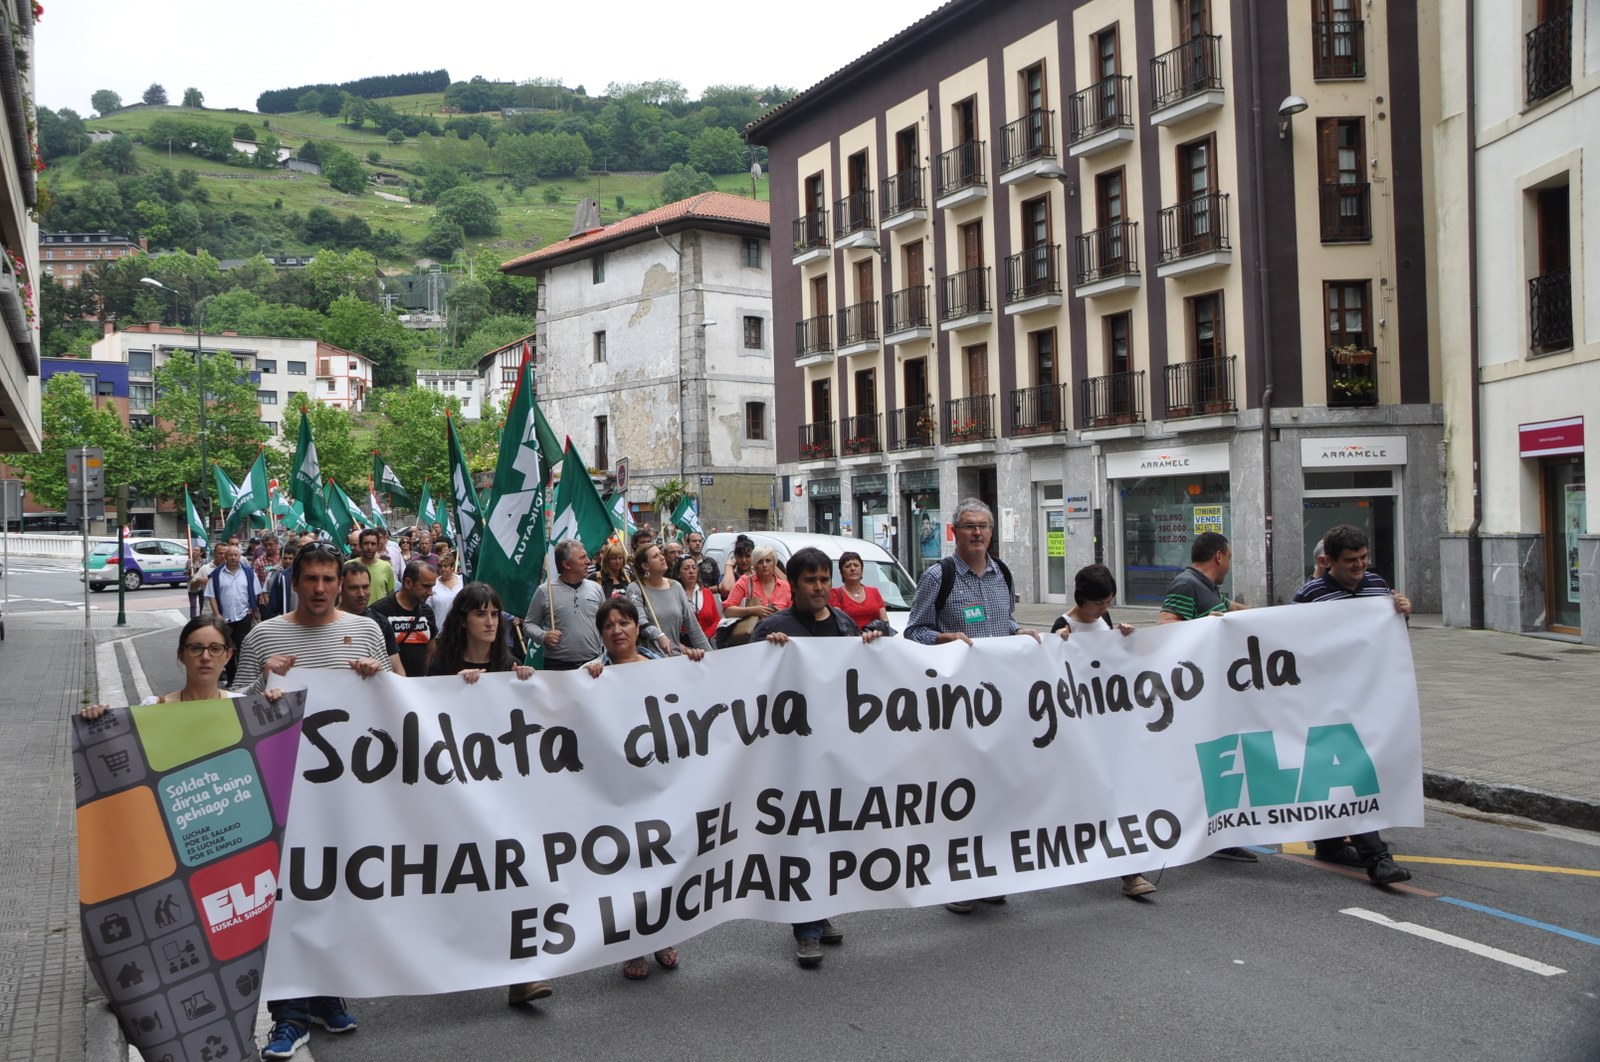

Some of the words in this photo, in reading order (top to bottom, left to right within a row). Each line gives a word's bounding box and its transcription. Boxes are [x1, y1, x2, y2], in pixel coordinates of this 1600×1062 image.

[1140, 459, 1190, 469] ARRAMELE
[1322, 450, 1387, 459] ARRAMELE
[1195, 515, 1222, 523] VENDE
[1201, 507, 1221, 515] MINER
[301, 707, 585, 786] Soldata
[623, 689, 813, 769] dirua
[845, 667, 1003, 734] baino
[1028, 660, 1205, 749] gehiago
[1226, 635, 1302, 692] da
[1194, 722, 1381, 819] ELA
[166, 771, 221, 799] Soldata
[171, 789, 211, 812] dirua
[213, 773, 253, 796] baino
[175, 797, 230, 831] gehiago
[233, 789, 253, 804] da
[1207, 810, 1262, 837] EUSKAL
[1267, 797, 1381, 825] SINDIKATUA
[182, 825, 211, 841] LUCHAR
[184, 836, 201, 848] POR
[201, 832, 210, 843] EL
[210, 822, 241, 839] SALARIO
[187, 846, 197, 856] ES
[197, 836, 225, 852] LUCHAR
[276, 838, 529, 902] UCHAR
[542, 819, 677, 883] POR
[695, 800, 739, 857] EL
[754, 777, 977, 837] SALARIO
[189, 851, 206, 862] POR
[207, 847, 216, 857] EL
[215, 836, 243, 854] EMPLEO
[201, 868, 278, 927] ELA
[509, 902, 576, 960] ES
[598, 852, 812, 946] LUCHAR
[829, 843, 932, 897] POR
[947, 835, 998, 882] EL
[1010, 808, 1182, 873] EMPLEO
[210, 916, 244, 934] EUSKAL
